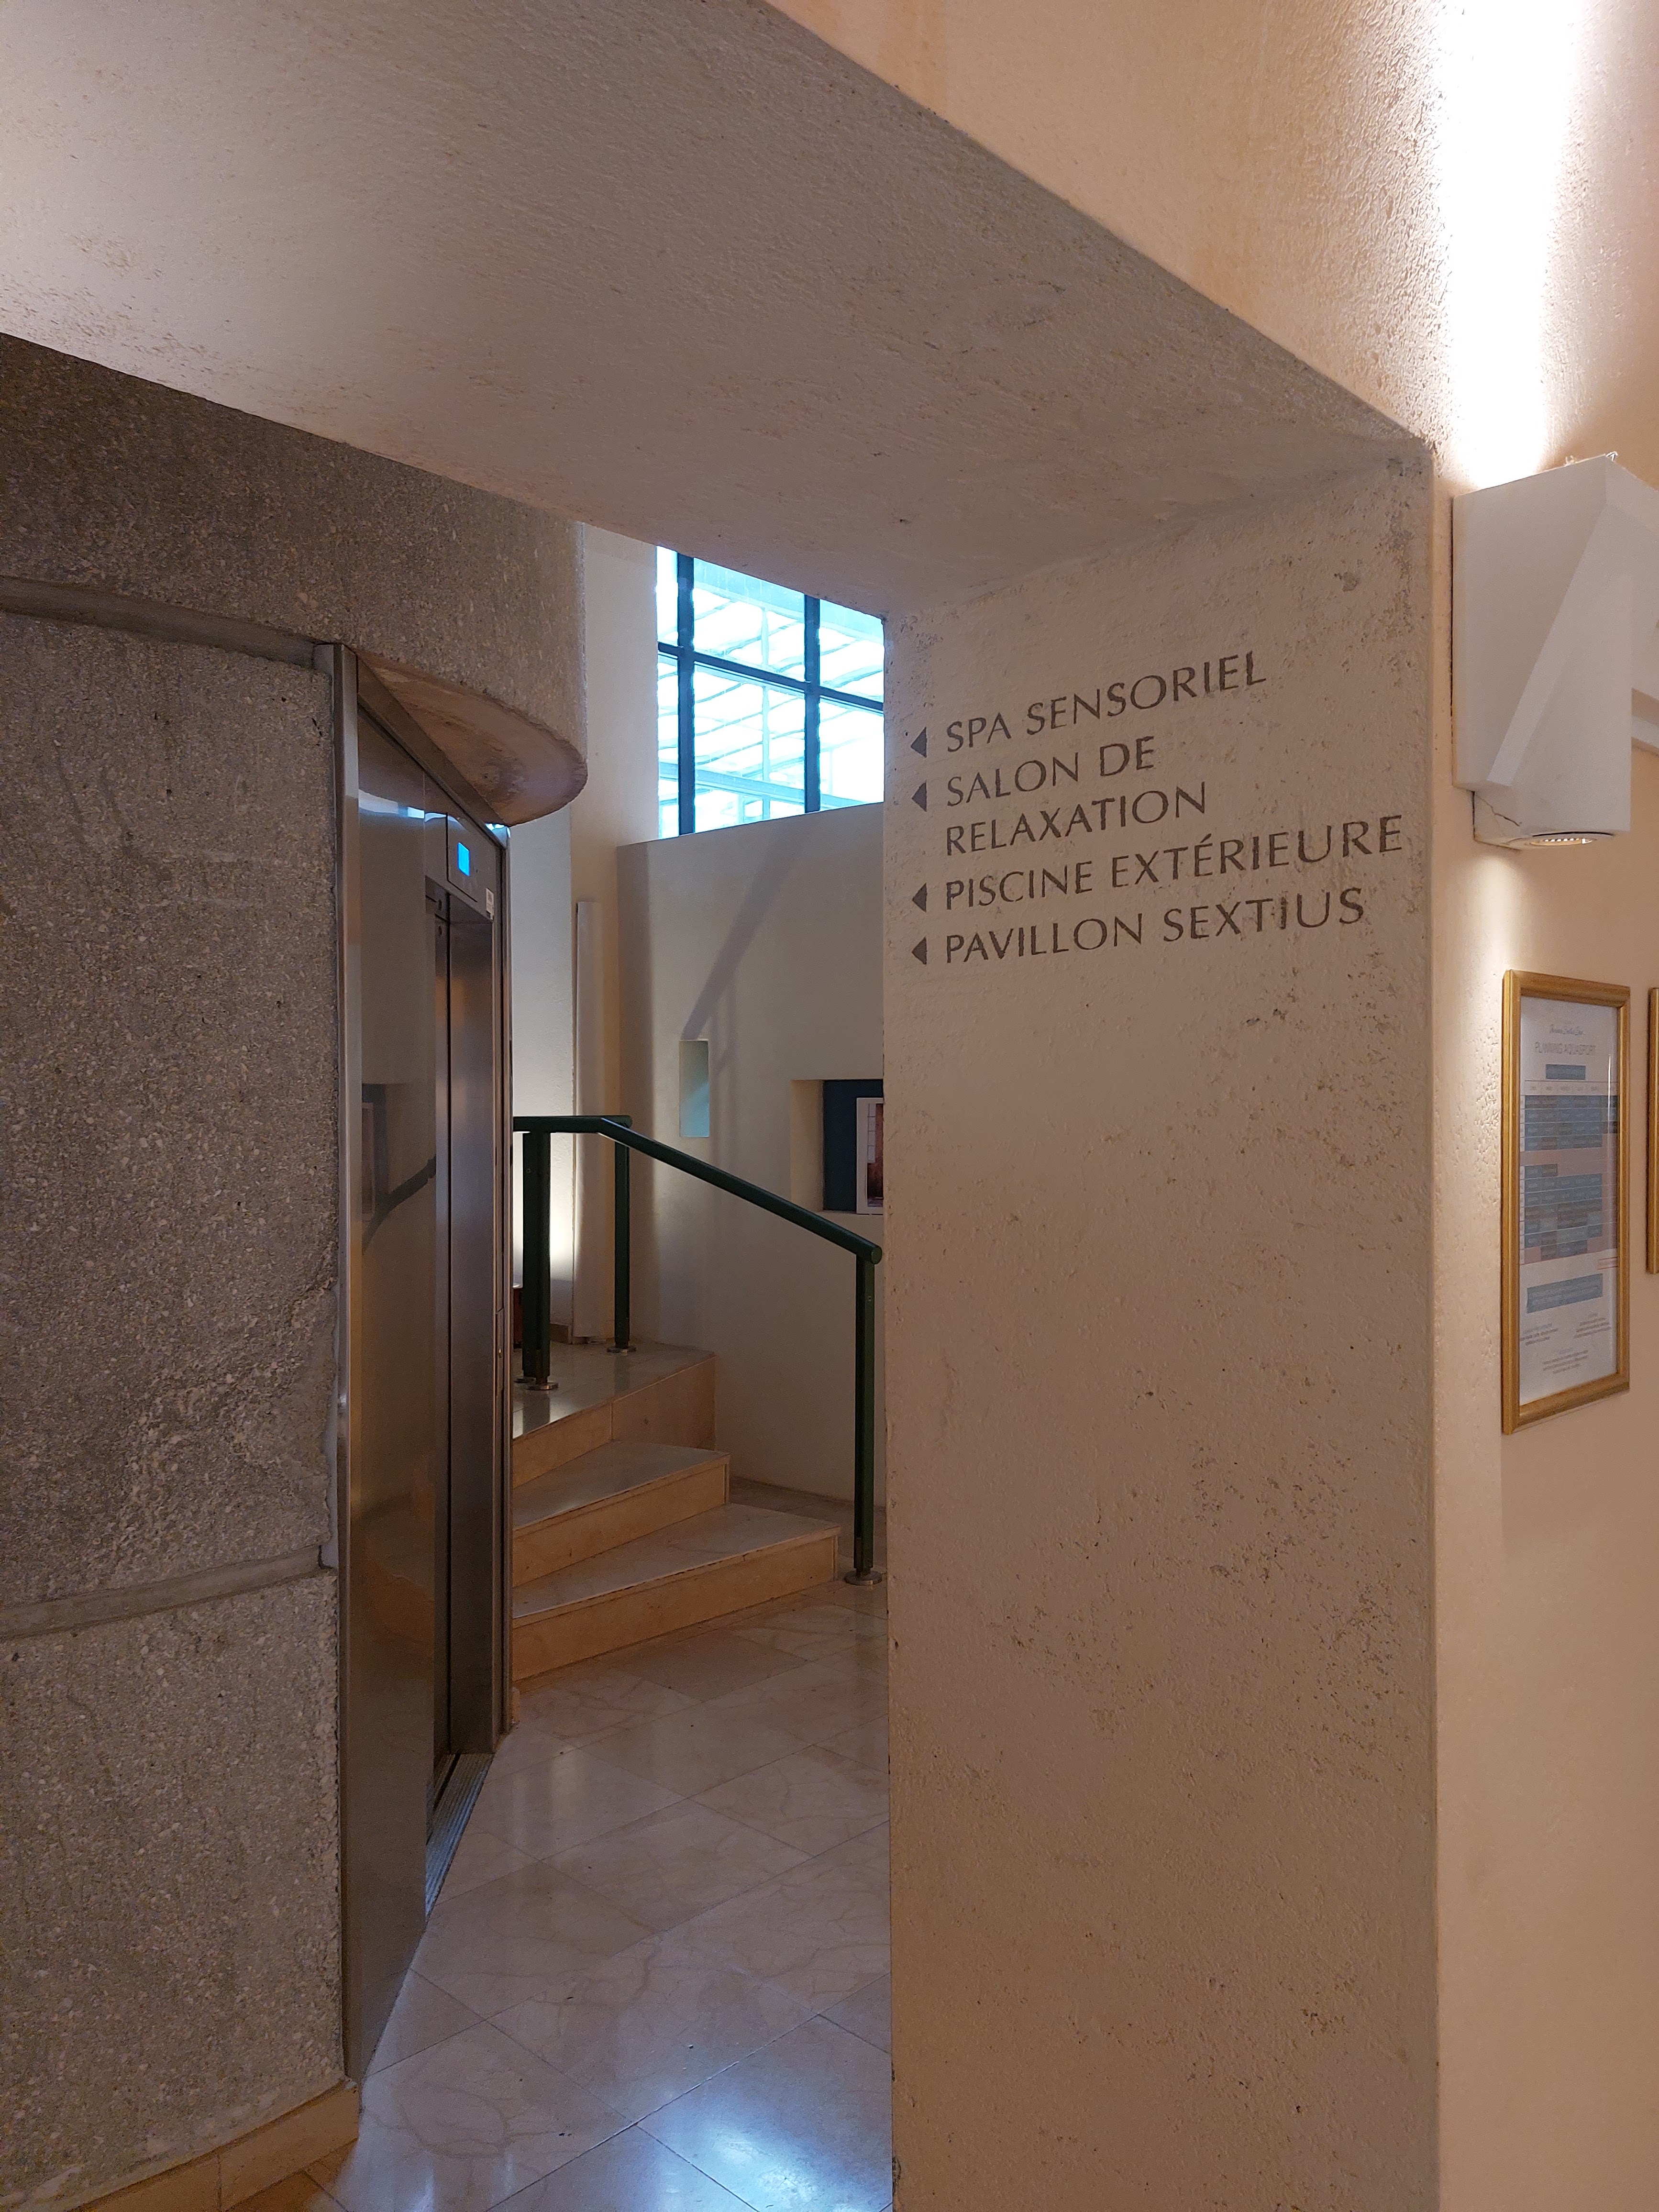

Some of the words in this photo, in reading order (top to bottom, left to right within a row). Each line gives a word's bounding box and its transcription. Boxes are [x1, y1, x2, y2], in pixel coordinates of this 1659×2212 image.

[946, 711, 1012, 753] SPA
[1026, 650, 1267, 736] SENSORIEL
[946, 752, 1079, 807] SALON
[1099, 735, 1155, 777] DE
[946, 781, 1206, 857] RELAXATION
[945, 860, 1093, 911] PISCINE
[1111, 814, 1403, 888] EXTÉRIEURE
[946, 912, 1143, 964] PAVILLON
[1162, 886, 1364, 942] SEXTIUS
